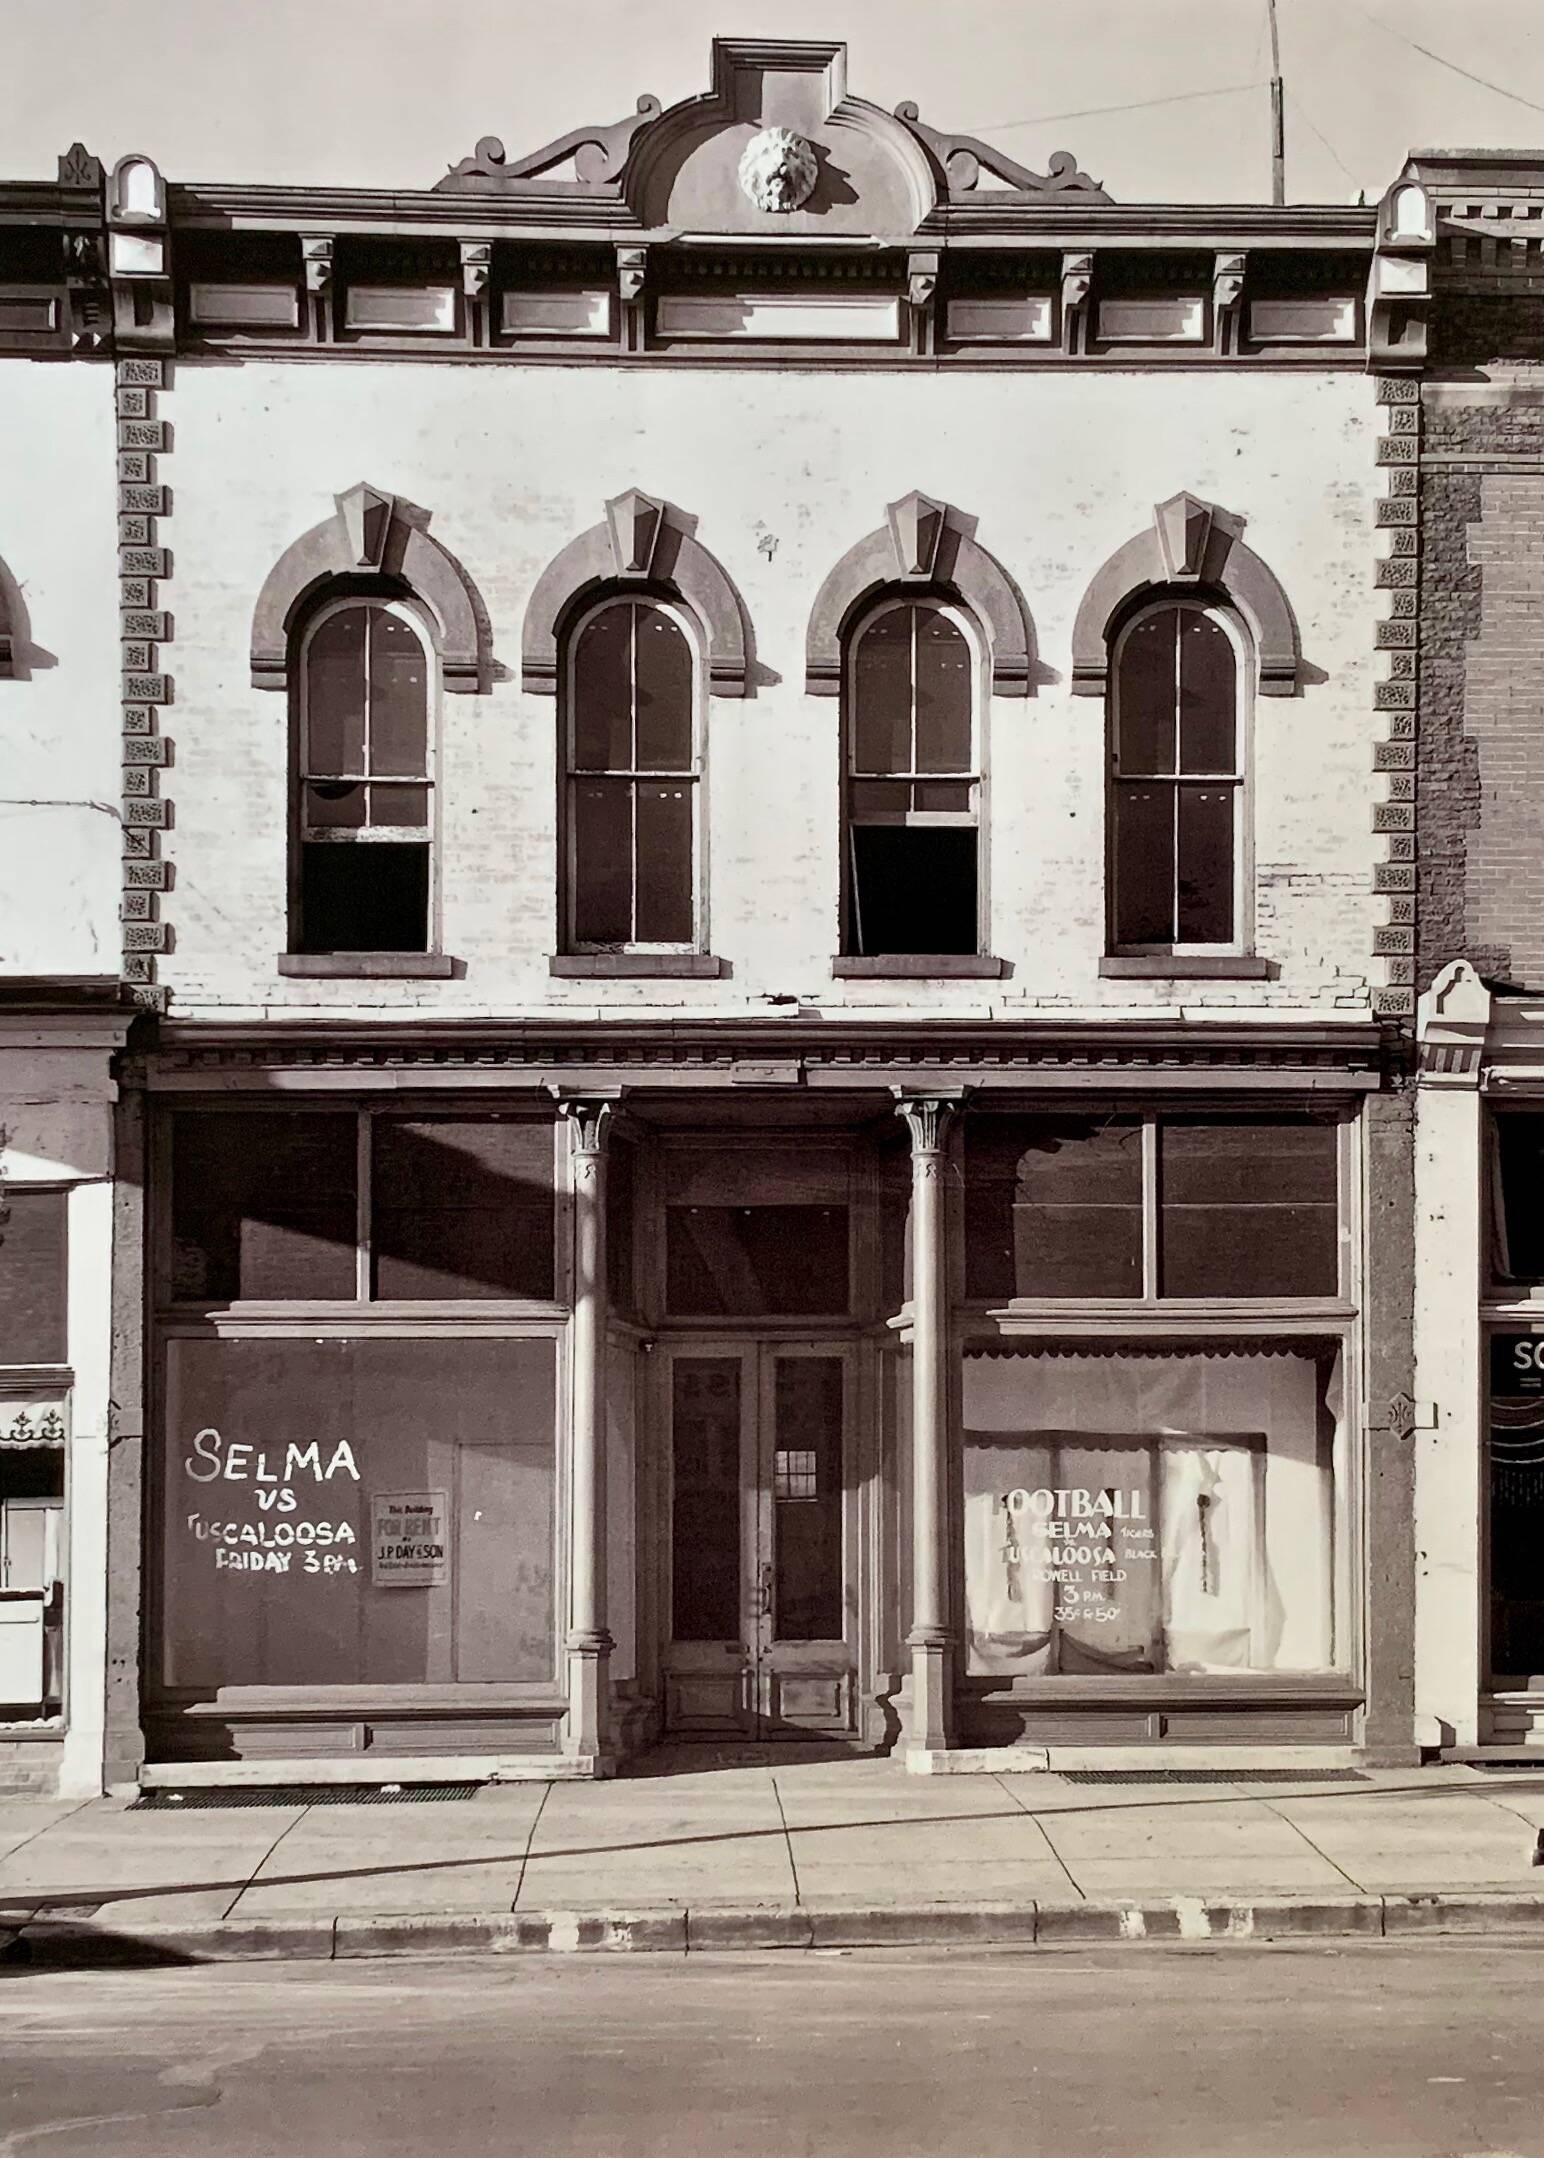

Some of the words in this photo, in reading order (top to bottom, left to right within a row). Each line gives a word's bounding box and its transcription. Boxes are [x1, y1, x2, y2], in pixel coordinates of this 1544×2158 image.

[185, 1428, 361, 1482] SELMA
[187, 1513, 356, 1547] TUSCALOOSA
[403, 1517, 441, 1536] RENT
[1031, 1521, 1112, 1540] SELMA
[216, 1548, 292, 1574] FRIDAY
[396, 1545, 416, 1560] DAY
[423, 1544, 444, 1559] SON
[1091, 1569, 1127, 1583] FIELD
[1063, 1585, 1080, 1605] 3
